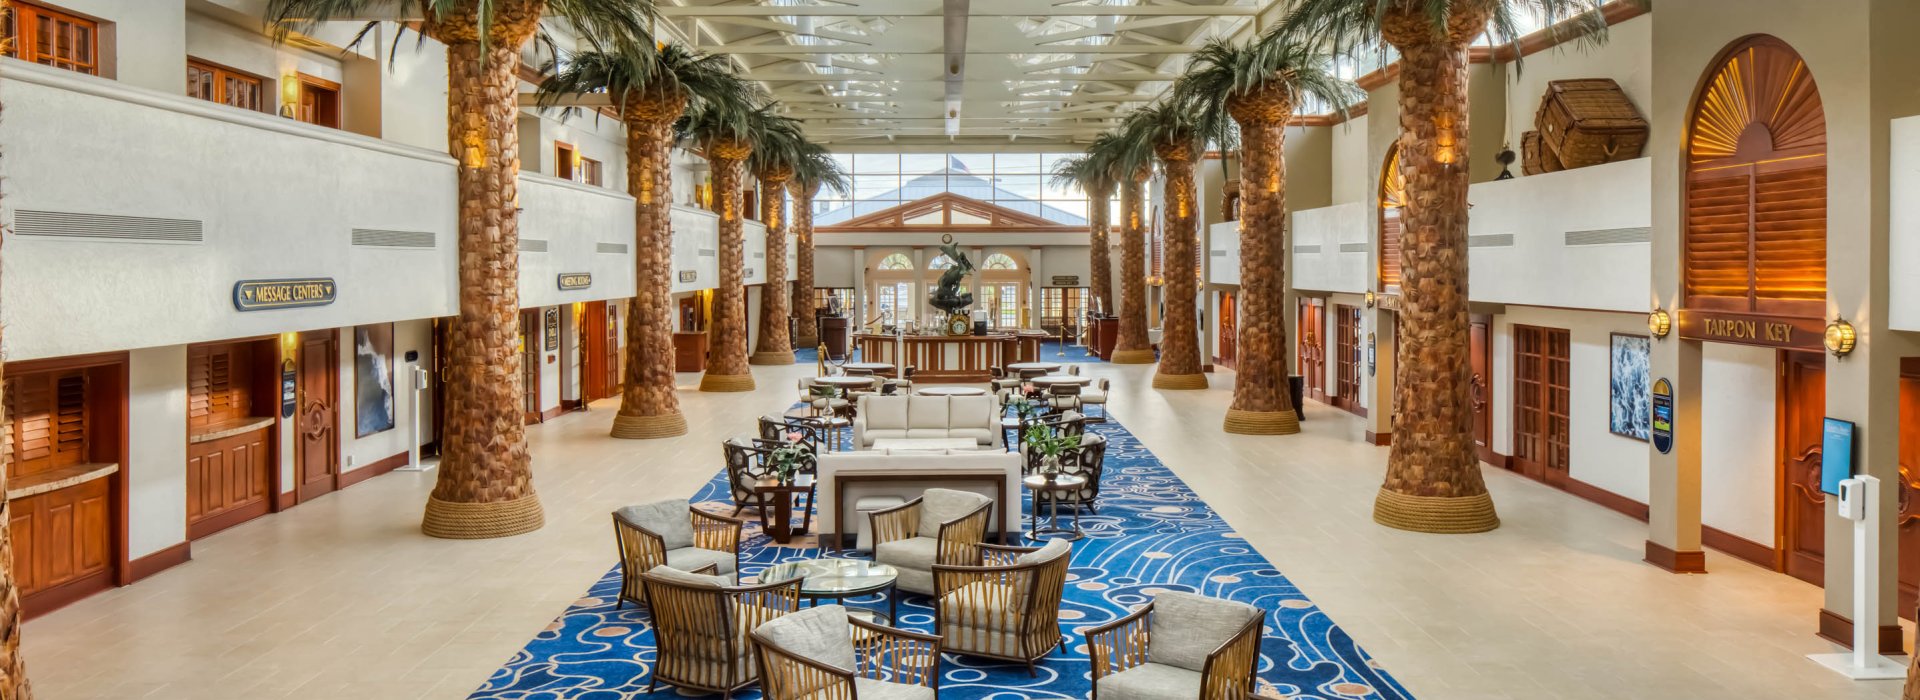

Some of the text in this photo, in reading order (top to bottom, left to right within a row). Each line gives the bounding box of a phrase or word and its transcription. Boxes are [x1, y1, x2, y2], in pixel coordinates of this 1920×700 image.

[255, 284, 324, 302] MESSAGE CENTERS
[1703, 318, 1792, 342] TARPON KEY
